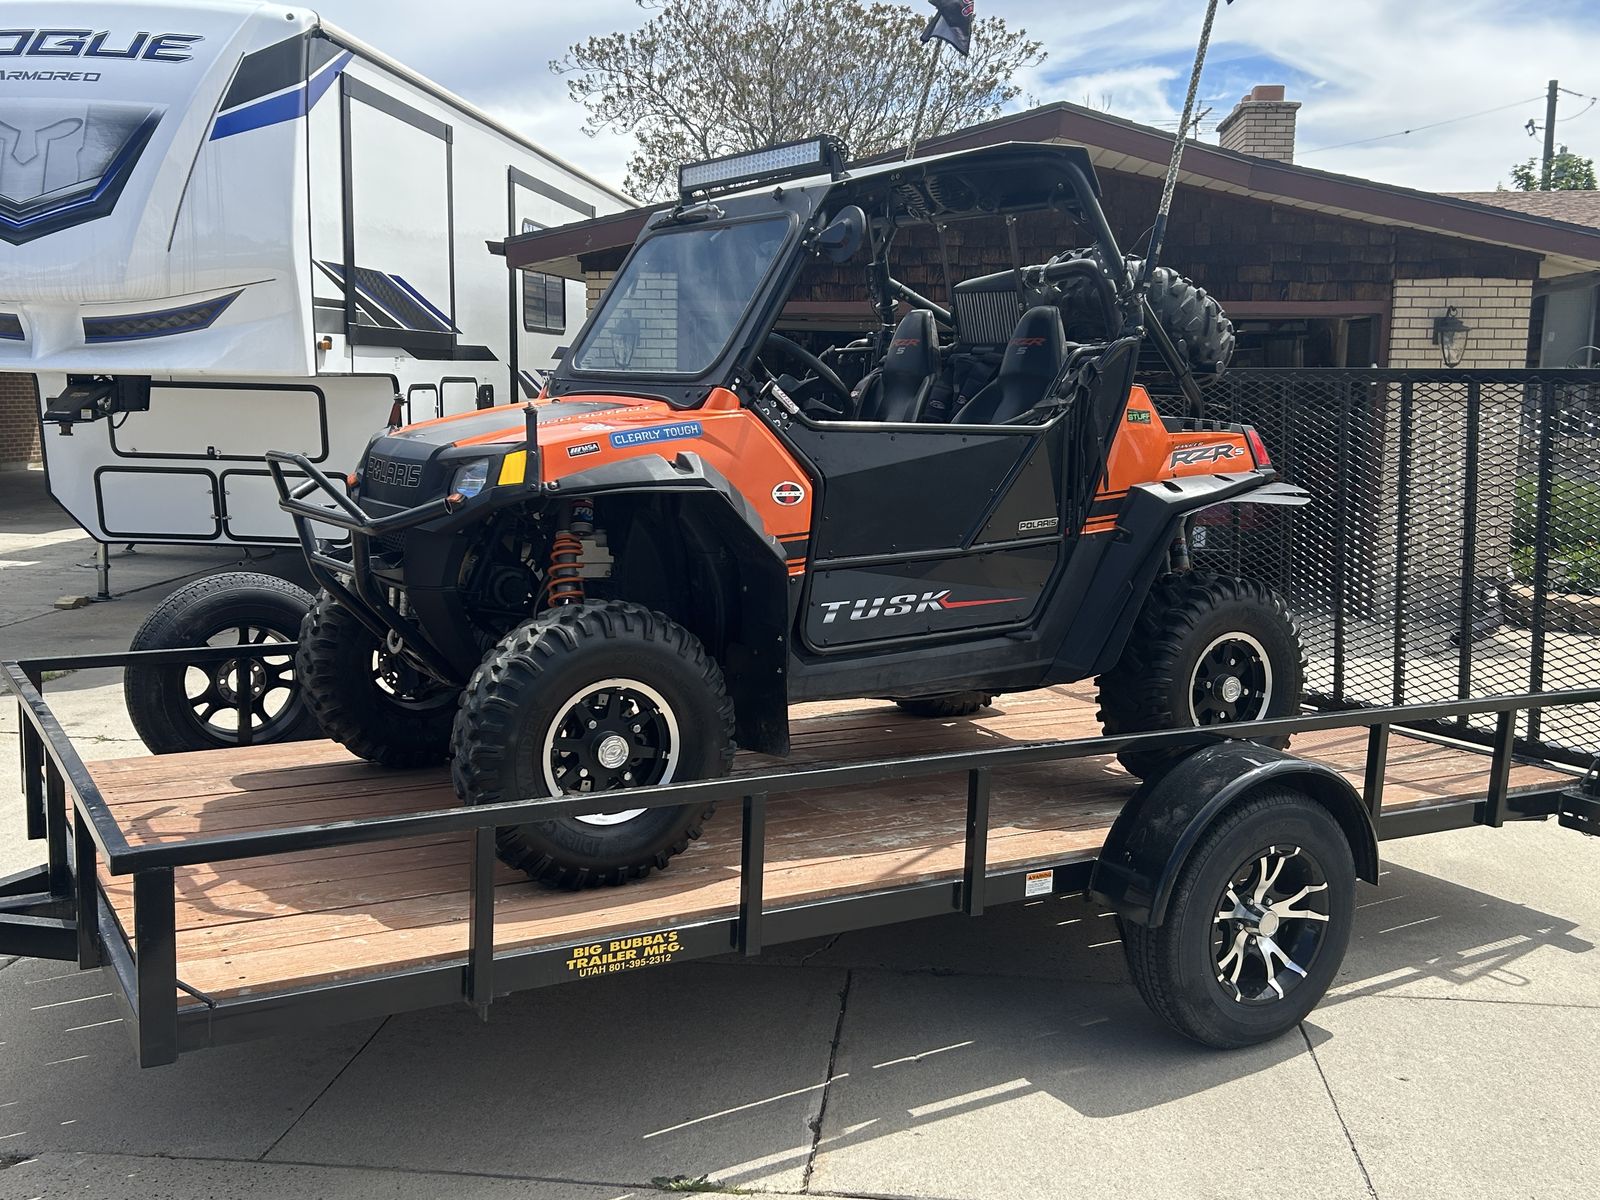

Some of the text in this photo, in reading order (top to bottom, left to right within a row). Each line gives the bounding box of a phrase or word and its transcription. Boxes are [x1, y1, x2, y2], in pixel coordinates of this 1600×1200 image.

[614, 424, 699, 445] CLEARLY TOUGH
[1169, 443, 1236, 470] RZR
[367, 456, 422, 488] POLARIS
[1019, 519, 1057, 530] POLARIS
[820, 589, 952, 624] TUSK
[566, 942, 684, 970] TRAILER MFG.
[573, 931, 678, 959] BIG BUBBA'S
[579, 954, 671, 977] UTAH 801-395-2312
